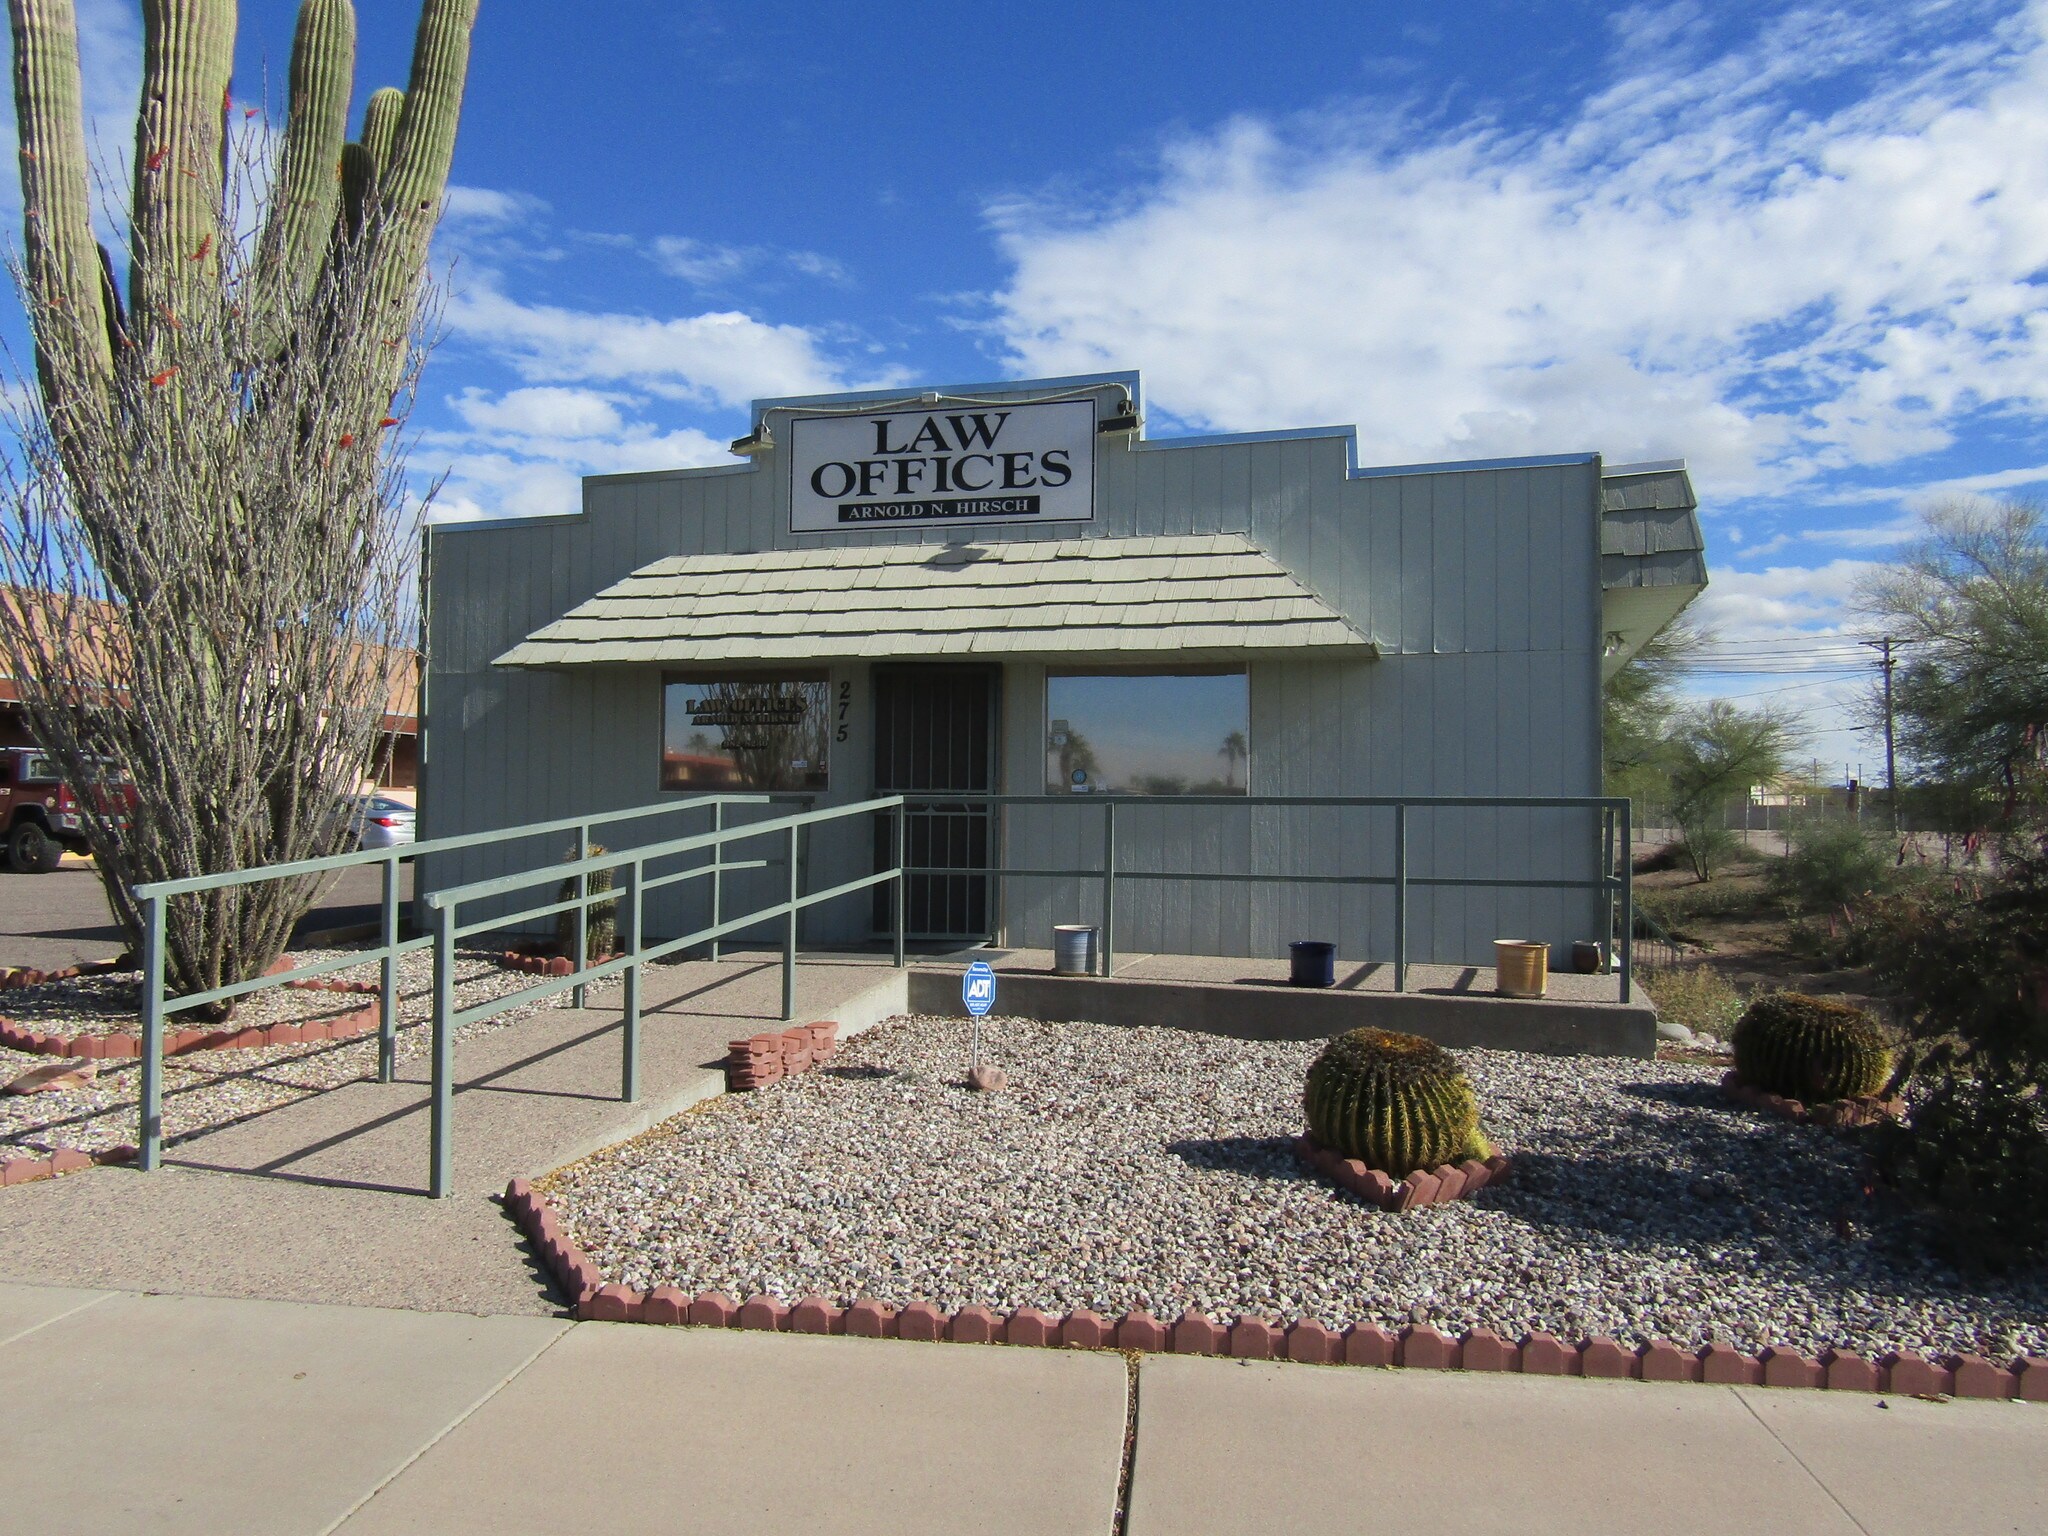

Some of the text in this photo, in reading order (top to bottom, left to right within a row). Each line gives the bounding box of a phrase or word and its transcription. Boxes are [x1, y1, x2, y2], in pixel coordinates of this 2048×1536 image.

[870, 412, 1012, 455] LAW
[810, 450, 1072, 498] OFFICES
[848, 499, 1029, 519] ARNOLD N. HIRSCH
[685, 697, 807, 714] LAW OFFICES
[837, 682, 850, 742] 275
[969, 979, 991, 997] ADT
